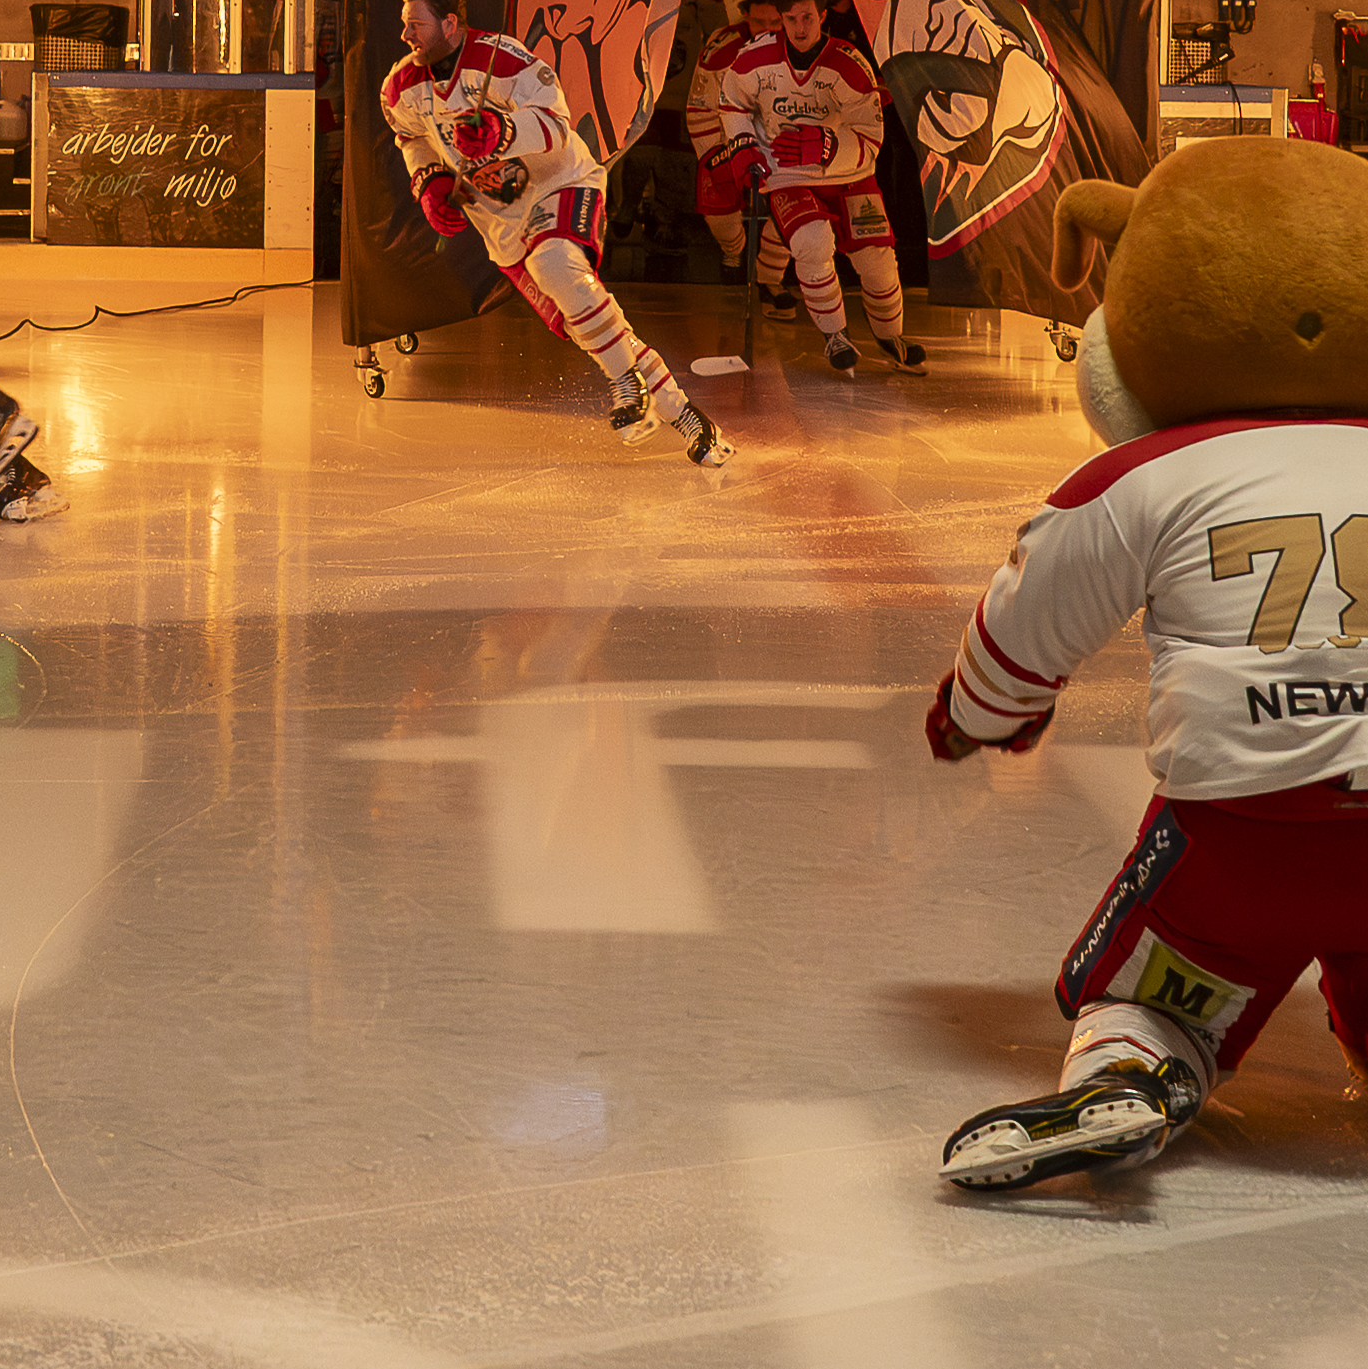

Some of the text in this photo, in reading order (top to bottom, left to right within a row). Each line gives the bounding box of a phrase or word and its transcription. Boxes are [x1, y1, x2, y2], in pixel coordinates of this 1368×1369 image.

[62, 123, 233, 165] arbejder for
[163, 167, 238, 208] miljø
